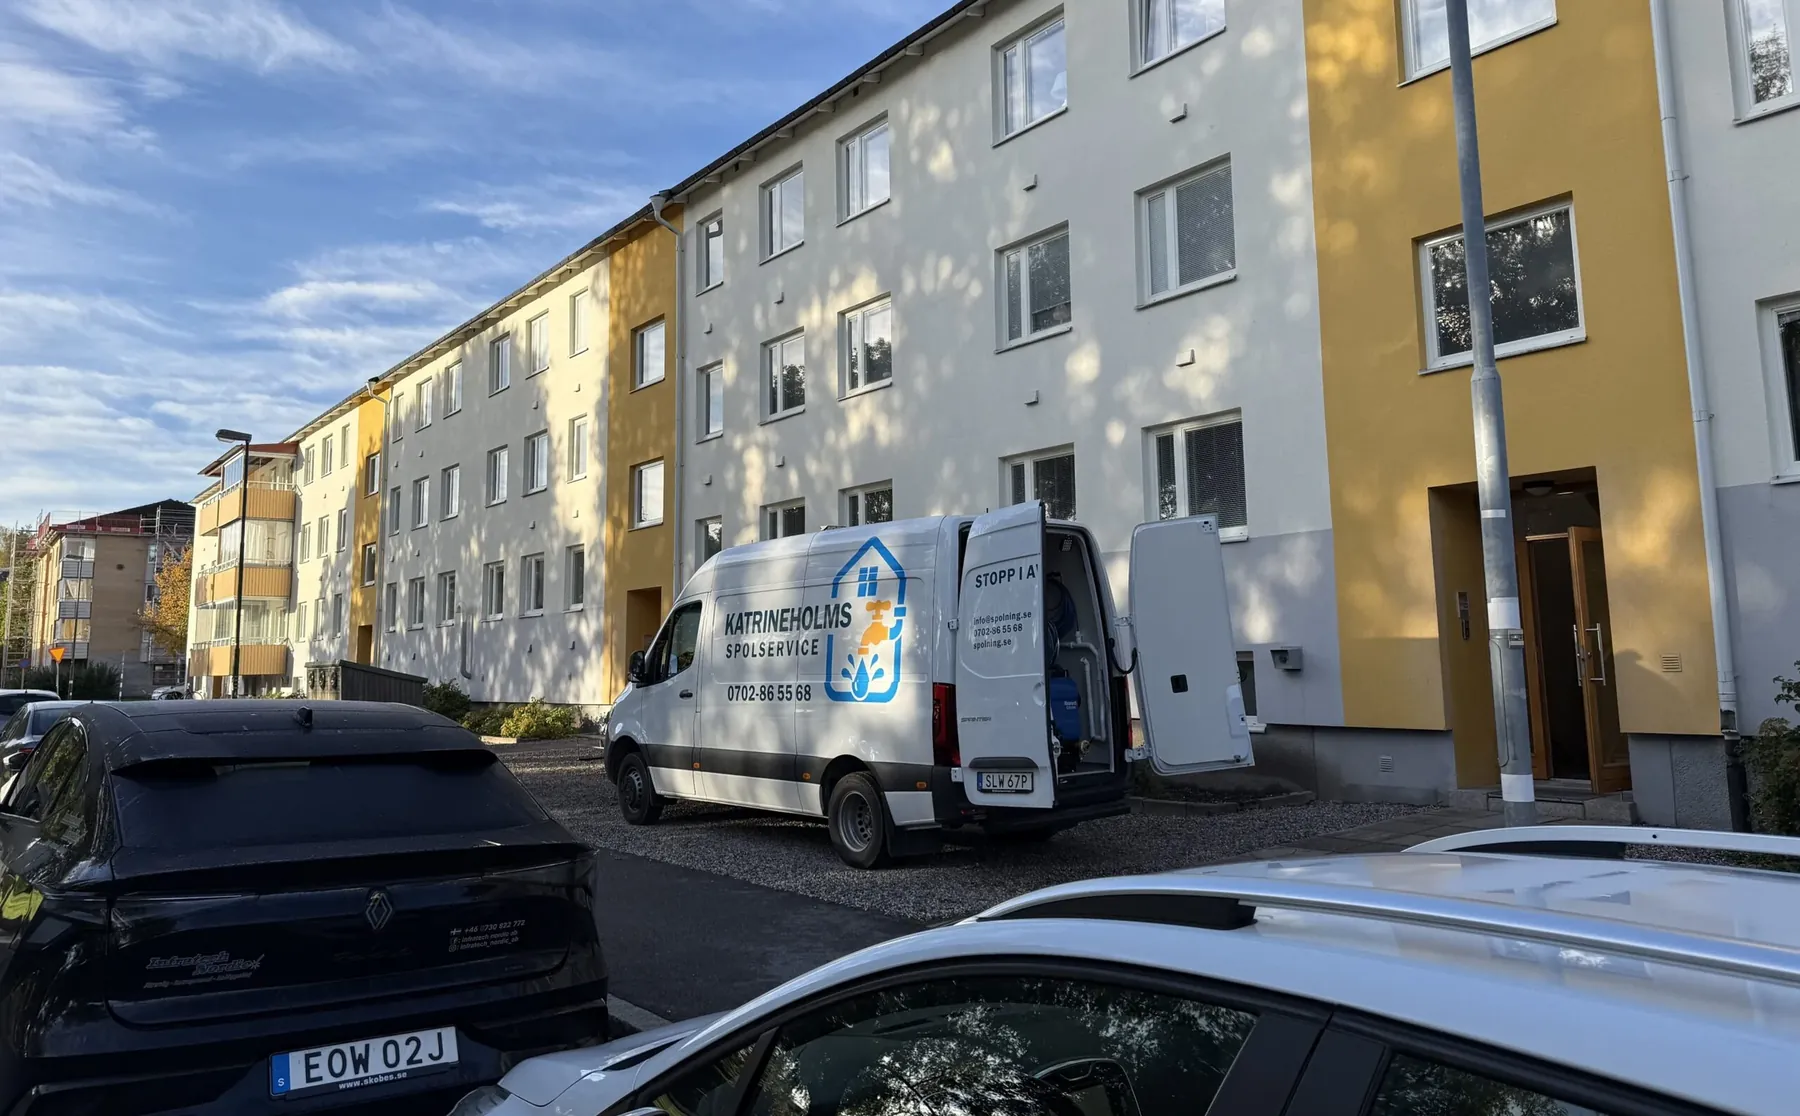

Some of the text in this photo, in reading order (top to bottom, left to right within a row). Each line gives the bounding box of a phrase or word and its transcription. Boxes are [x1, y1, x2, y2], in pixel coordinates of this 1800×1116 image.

[975, 568, 1015, 588] STOPP
[1019, 566, 1023, 580] I
[724, 602, 852, 636] KATRINEHOLMS
[973, 611, 1032, 625] info@spolning.se
[974, 623, 1023, 637] 0702-86 55 68
[725, 638, 819, 659] SPOLSERVICE
[973, 639, 1012, 650] spolning.se
[727, 684, 812, 701] 0702-86 55 68
[985, 774, 1028, 788] SLW 67P
[304, 1032, 445, 1084] EOW 02J
[277, 1078, 285, 1087] S
[339, 1070, 408, 1090] www.skobes.se
